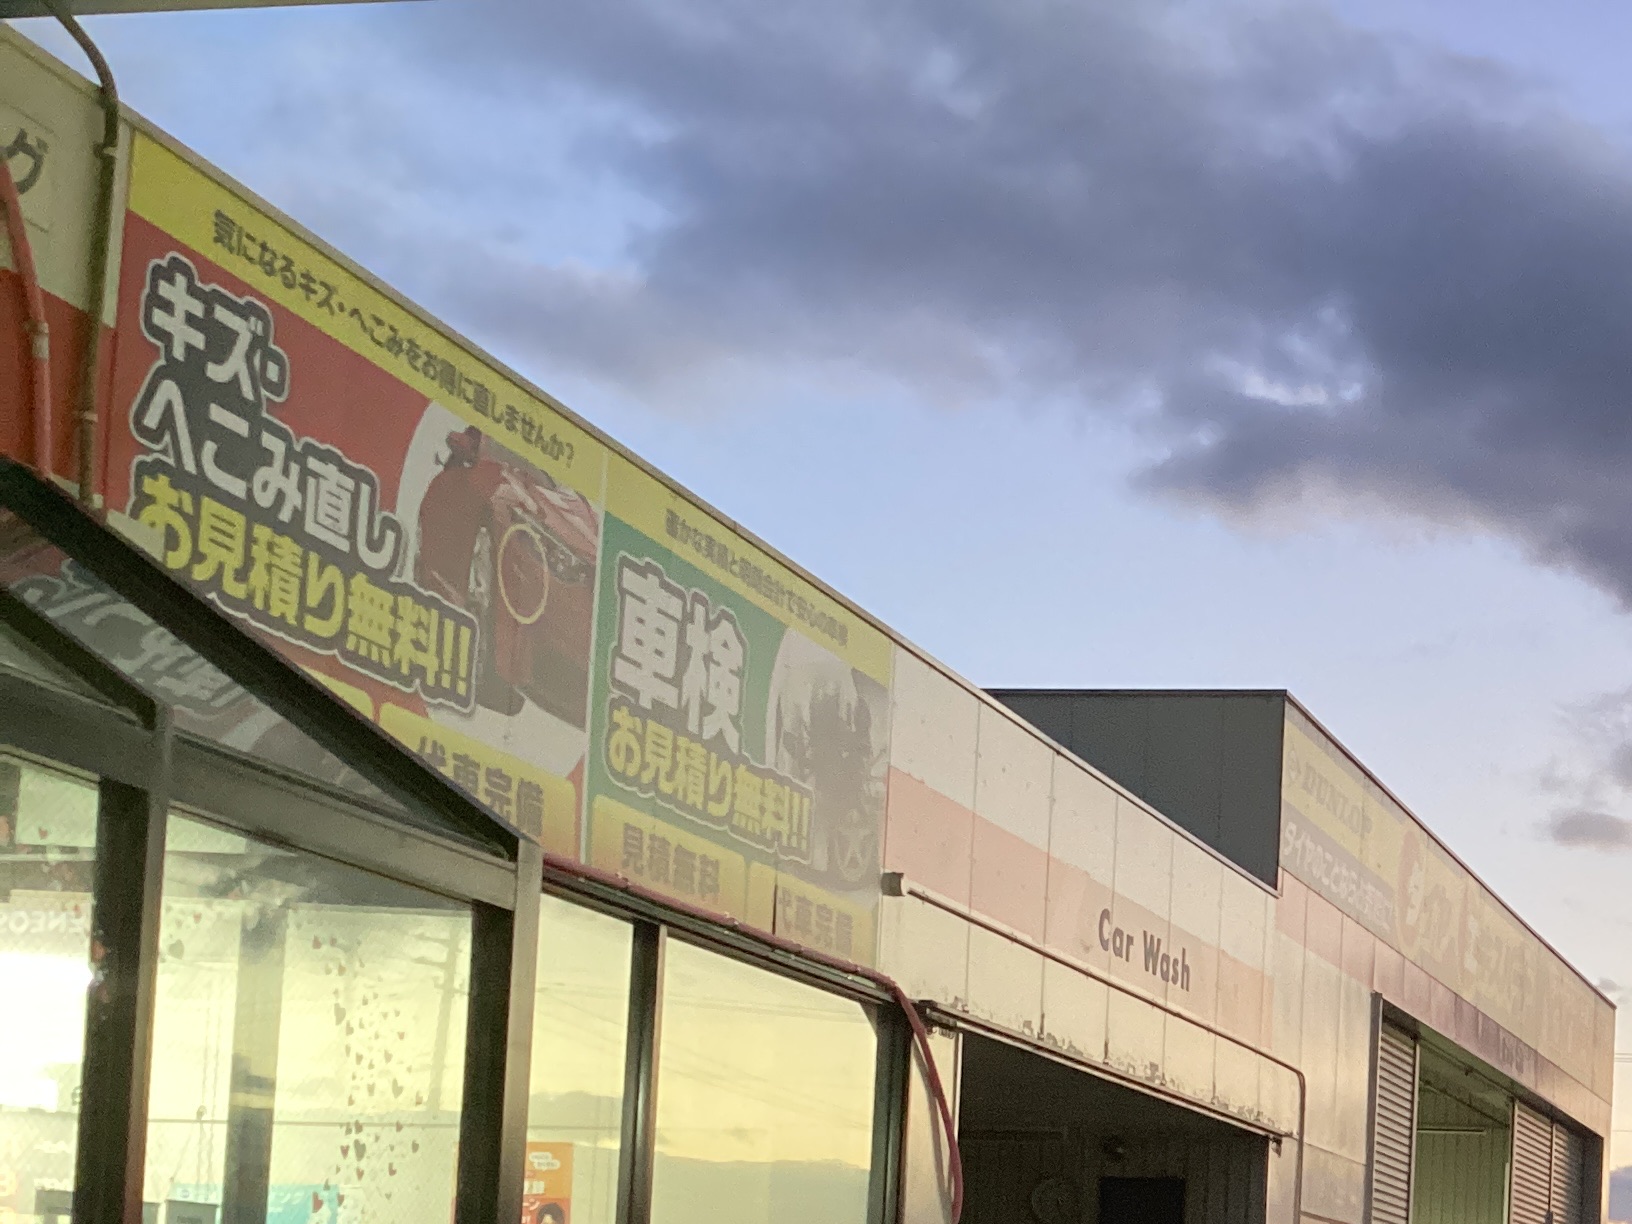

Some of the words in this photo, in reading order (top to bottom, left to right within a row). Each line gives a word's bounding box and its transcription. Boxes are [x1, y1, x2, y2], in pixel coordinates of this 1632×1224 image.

[143, 378, 397, 570] へこみ直し
[139, 474, 472, 698] お見積り無料!!
[611, 568, 745, 752] 車検
[608, 706, 810, 853] お見積り無料!!
[1303, 760, 1374, 835] DUNLOP
[622, 822, 720, 907] 見積無料
[1099, 909, 1135, 966] Car
[1143, 930, 1191, 992] Wash
